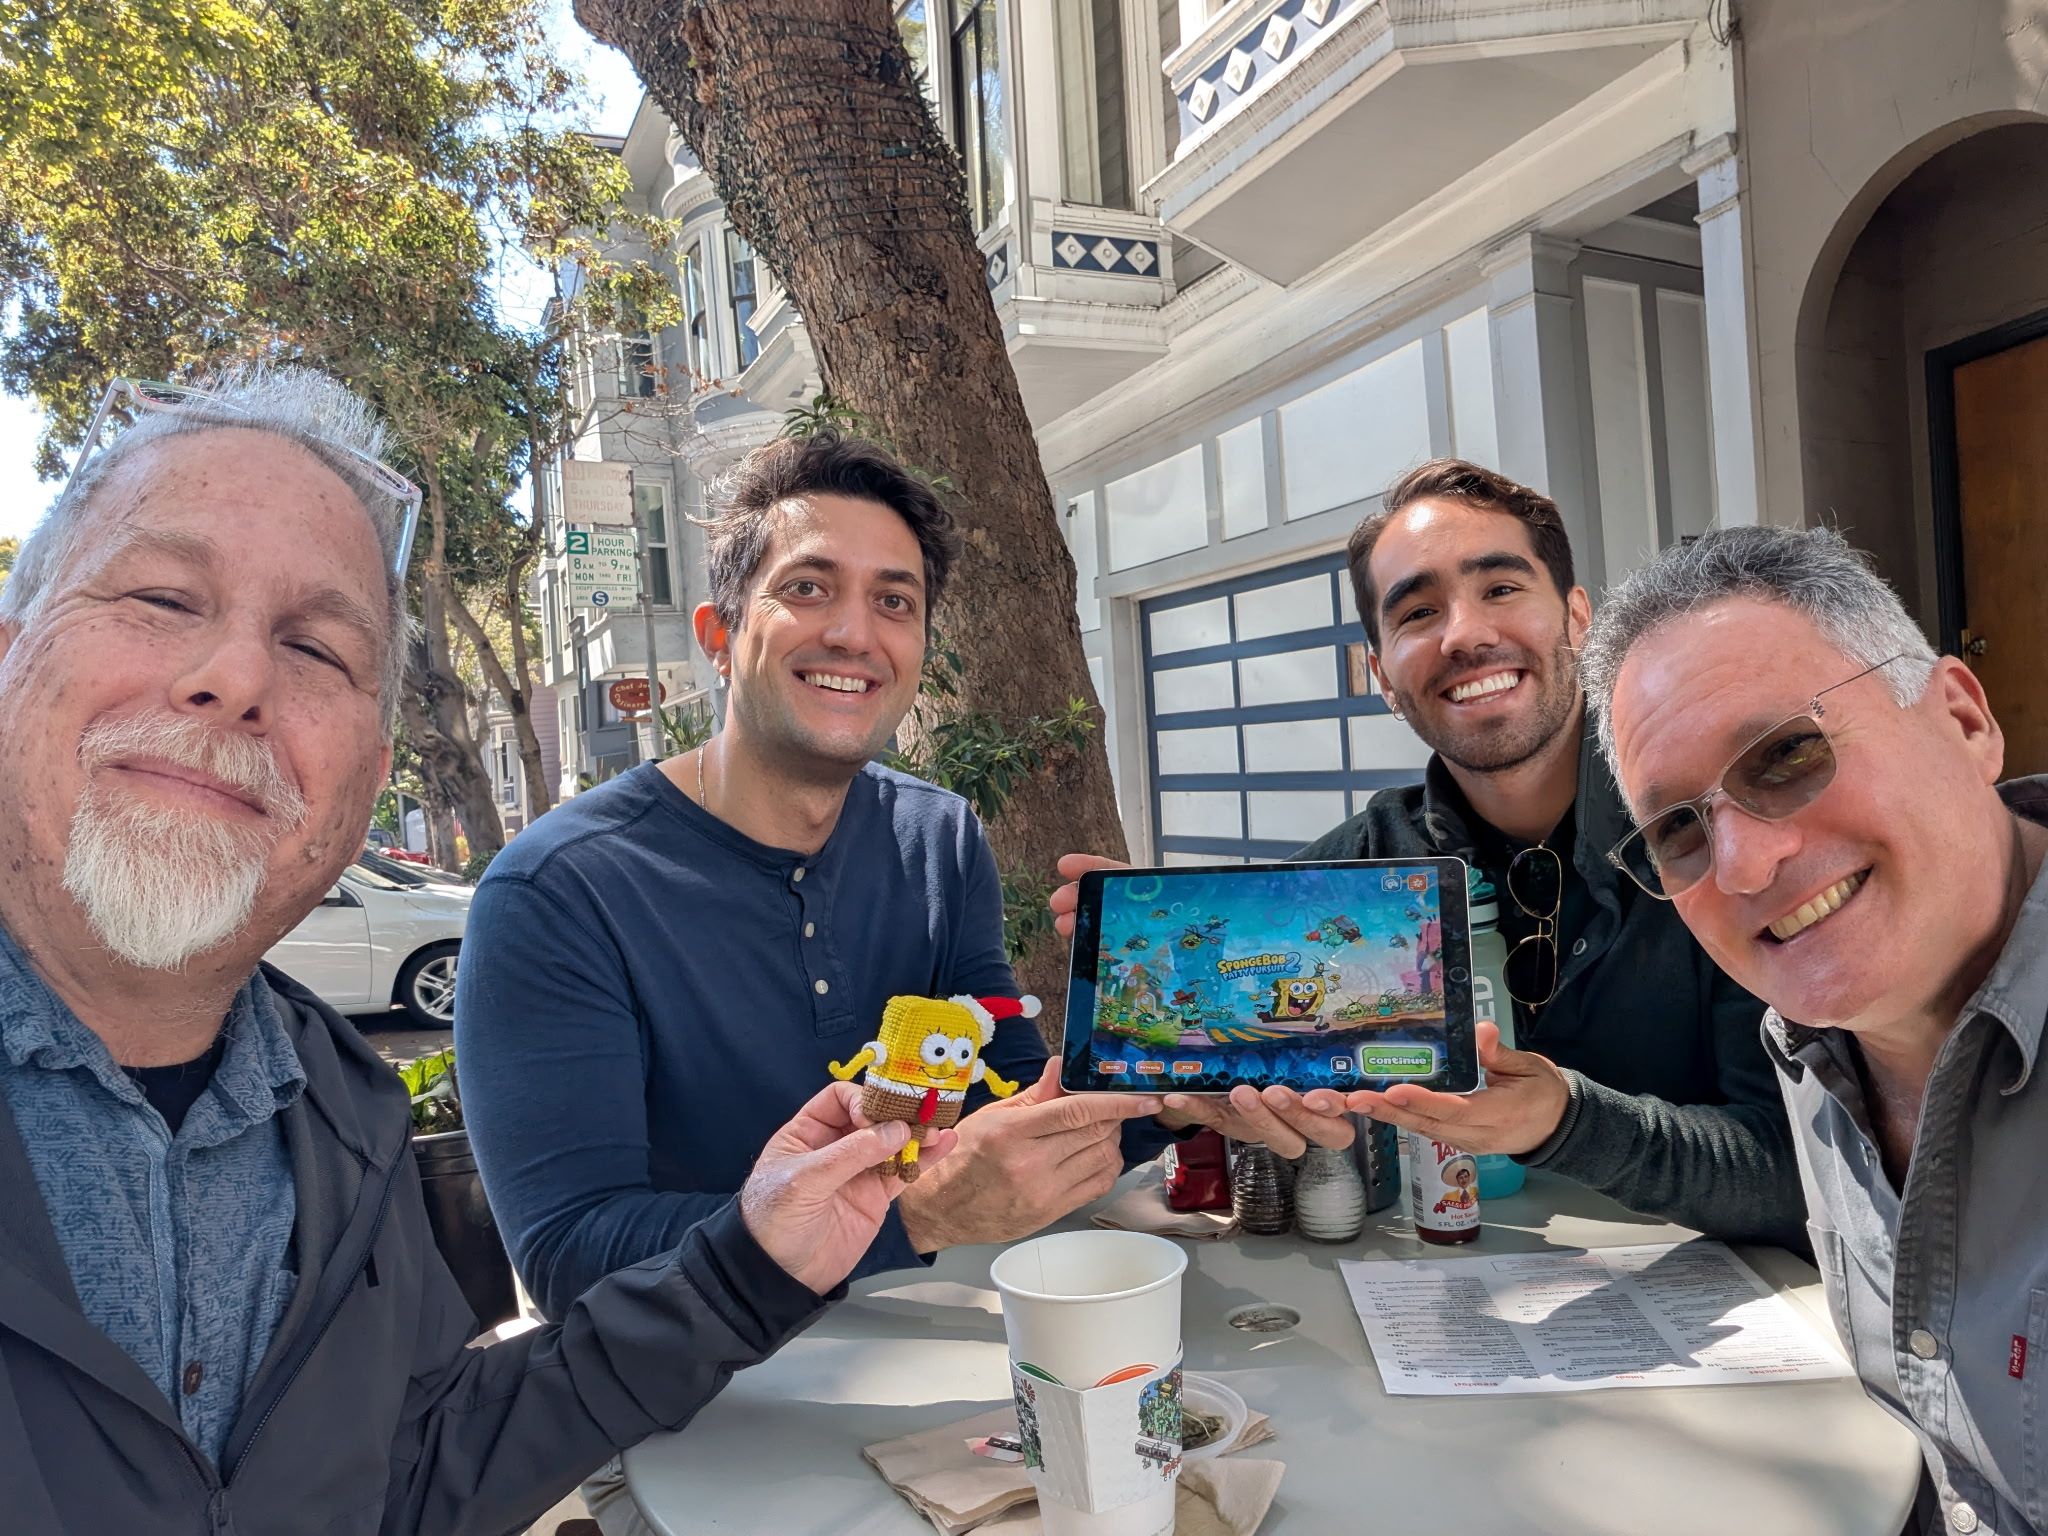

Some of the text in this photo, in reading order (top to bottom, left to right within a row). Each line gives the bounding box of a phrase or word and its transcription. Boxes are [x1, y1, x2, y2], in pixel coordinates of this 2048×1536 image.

[573, 500, 625, 512] THURSDAY
[570, 535, 625, 551] 2 HOUR
[592, 548, 632, 557] PARKING
[575, 573, 594, 581] MON
[617, 574, 632, 582] FRI
[595, 593, 606, 605] S
[615, 683, 634, 692] Chef
[614, 693, 645, 708] Culinary
[1222, 952, 1301, 981] PATTY PURSUIT 2
